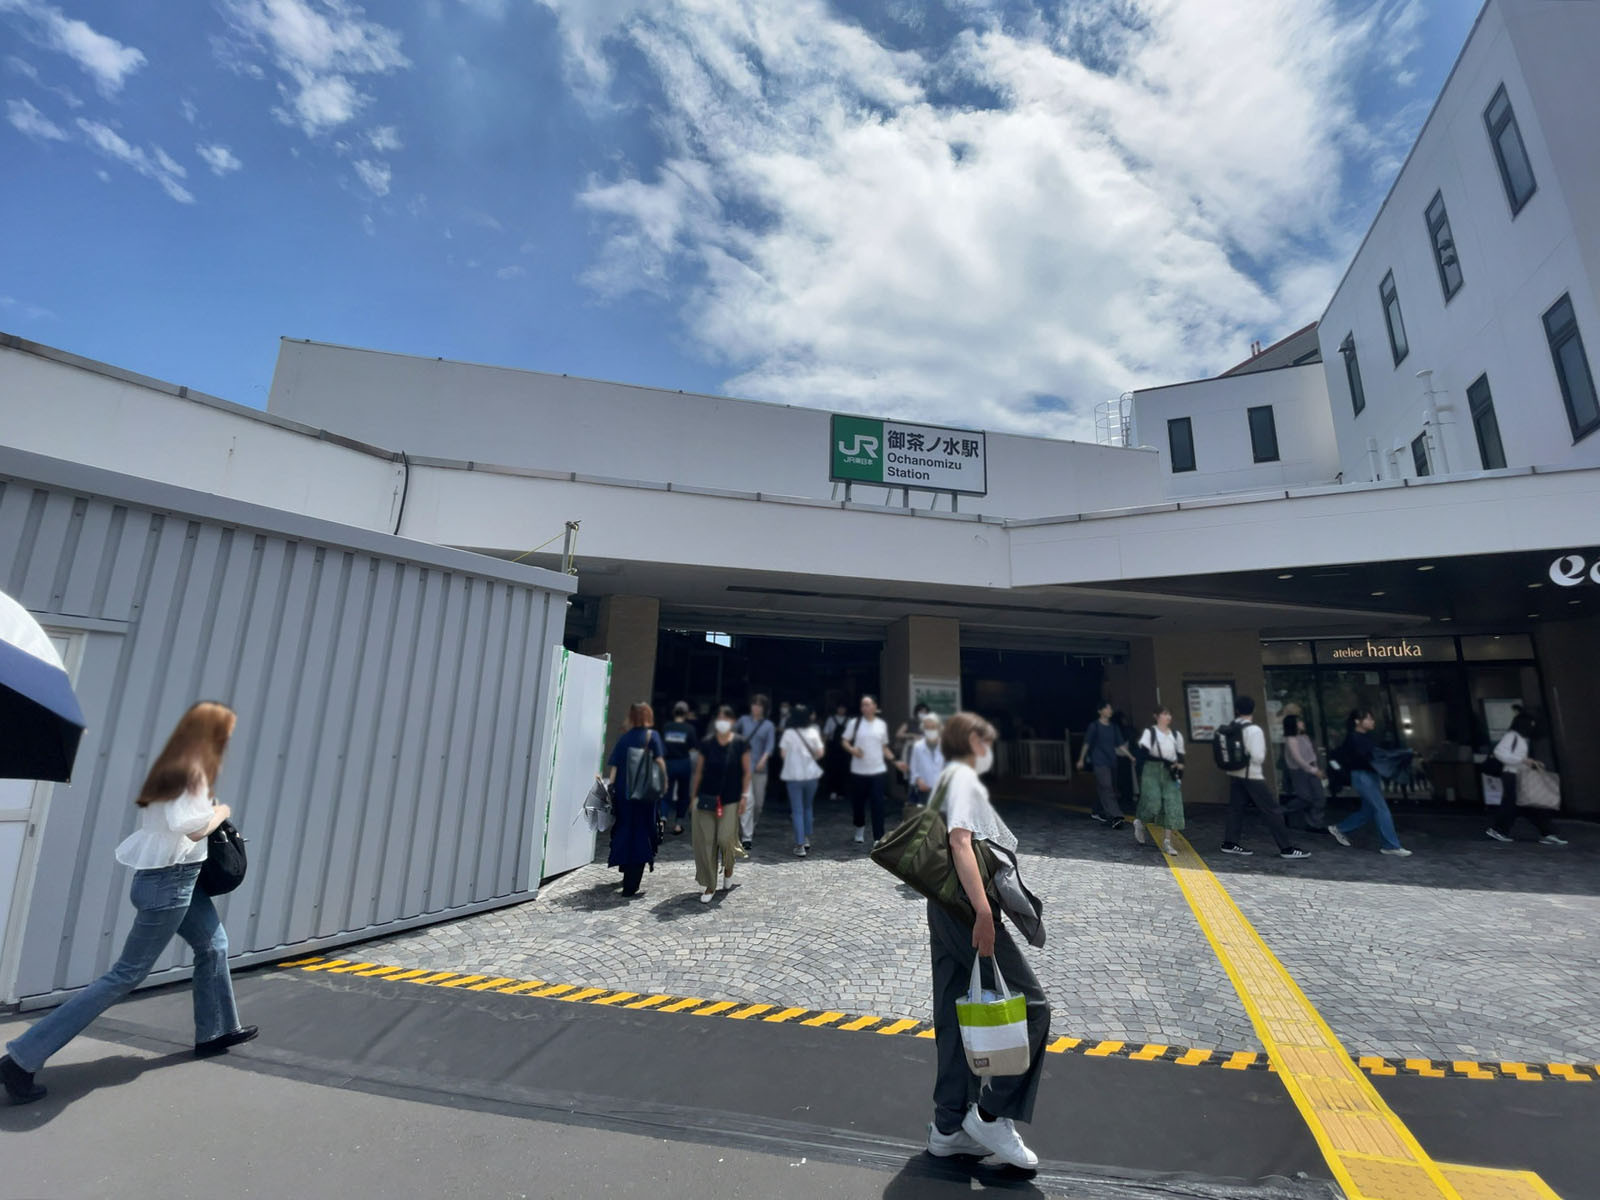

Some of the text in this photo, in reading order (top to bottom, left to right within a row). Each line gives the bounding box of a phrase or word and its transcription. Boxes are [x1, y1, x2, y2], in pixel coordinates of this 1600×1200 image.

[838, 434, 879, 459] JR
[887, 429, 980, 459] 御茶ノ水駅
[887, 452, 962, 471] Ochanomizu
[887, 466, 930, 481] Station
[1333, 640, 1422, 658] atelier haruka
